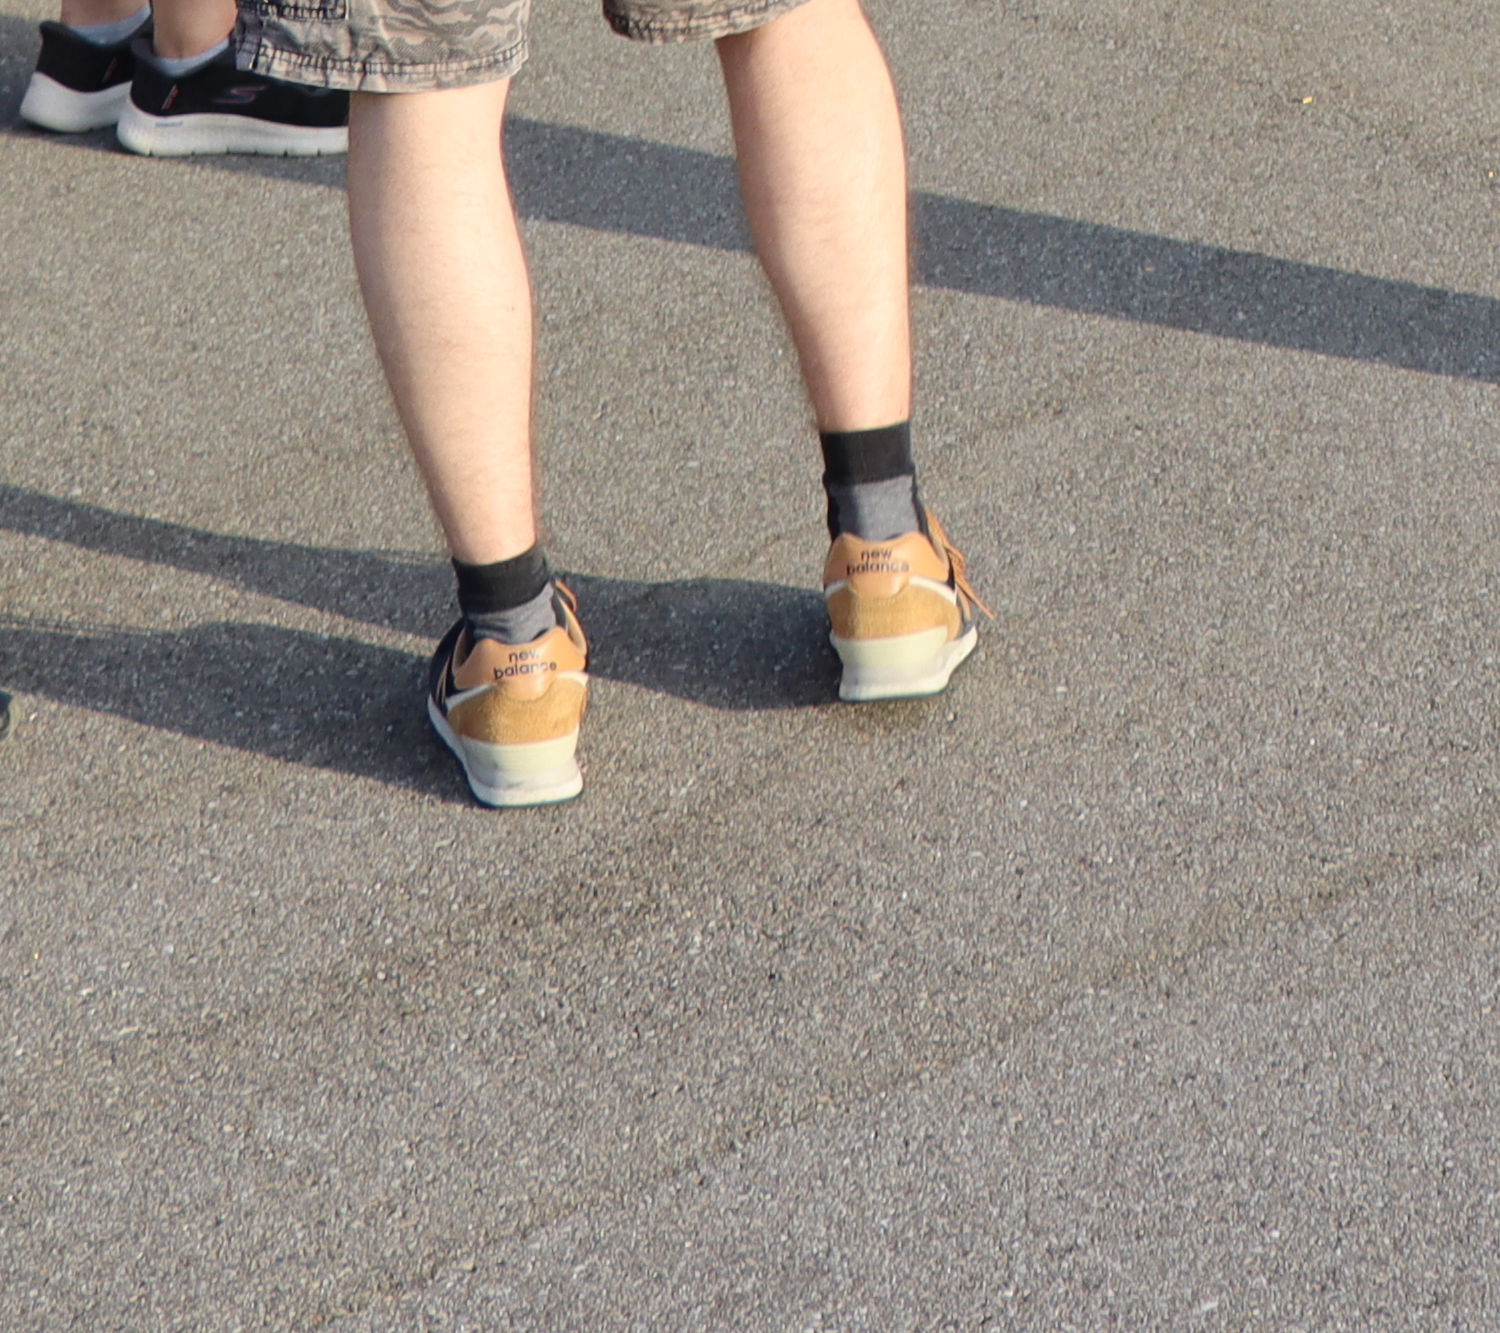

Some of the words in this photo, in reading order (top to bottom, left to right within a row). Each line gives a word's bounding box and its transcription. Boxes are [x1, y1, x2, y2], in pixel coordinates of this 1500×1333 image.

[861, 547, 893, 562] new
[846, 560, 910, 577] balance
[493, 660, 557, 680] balance
